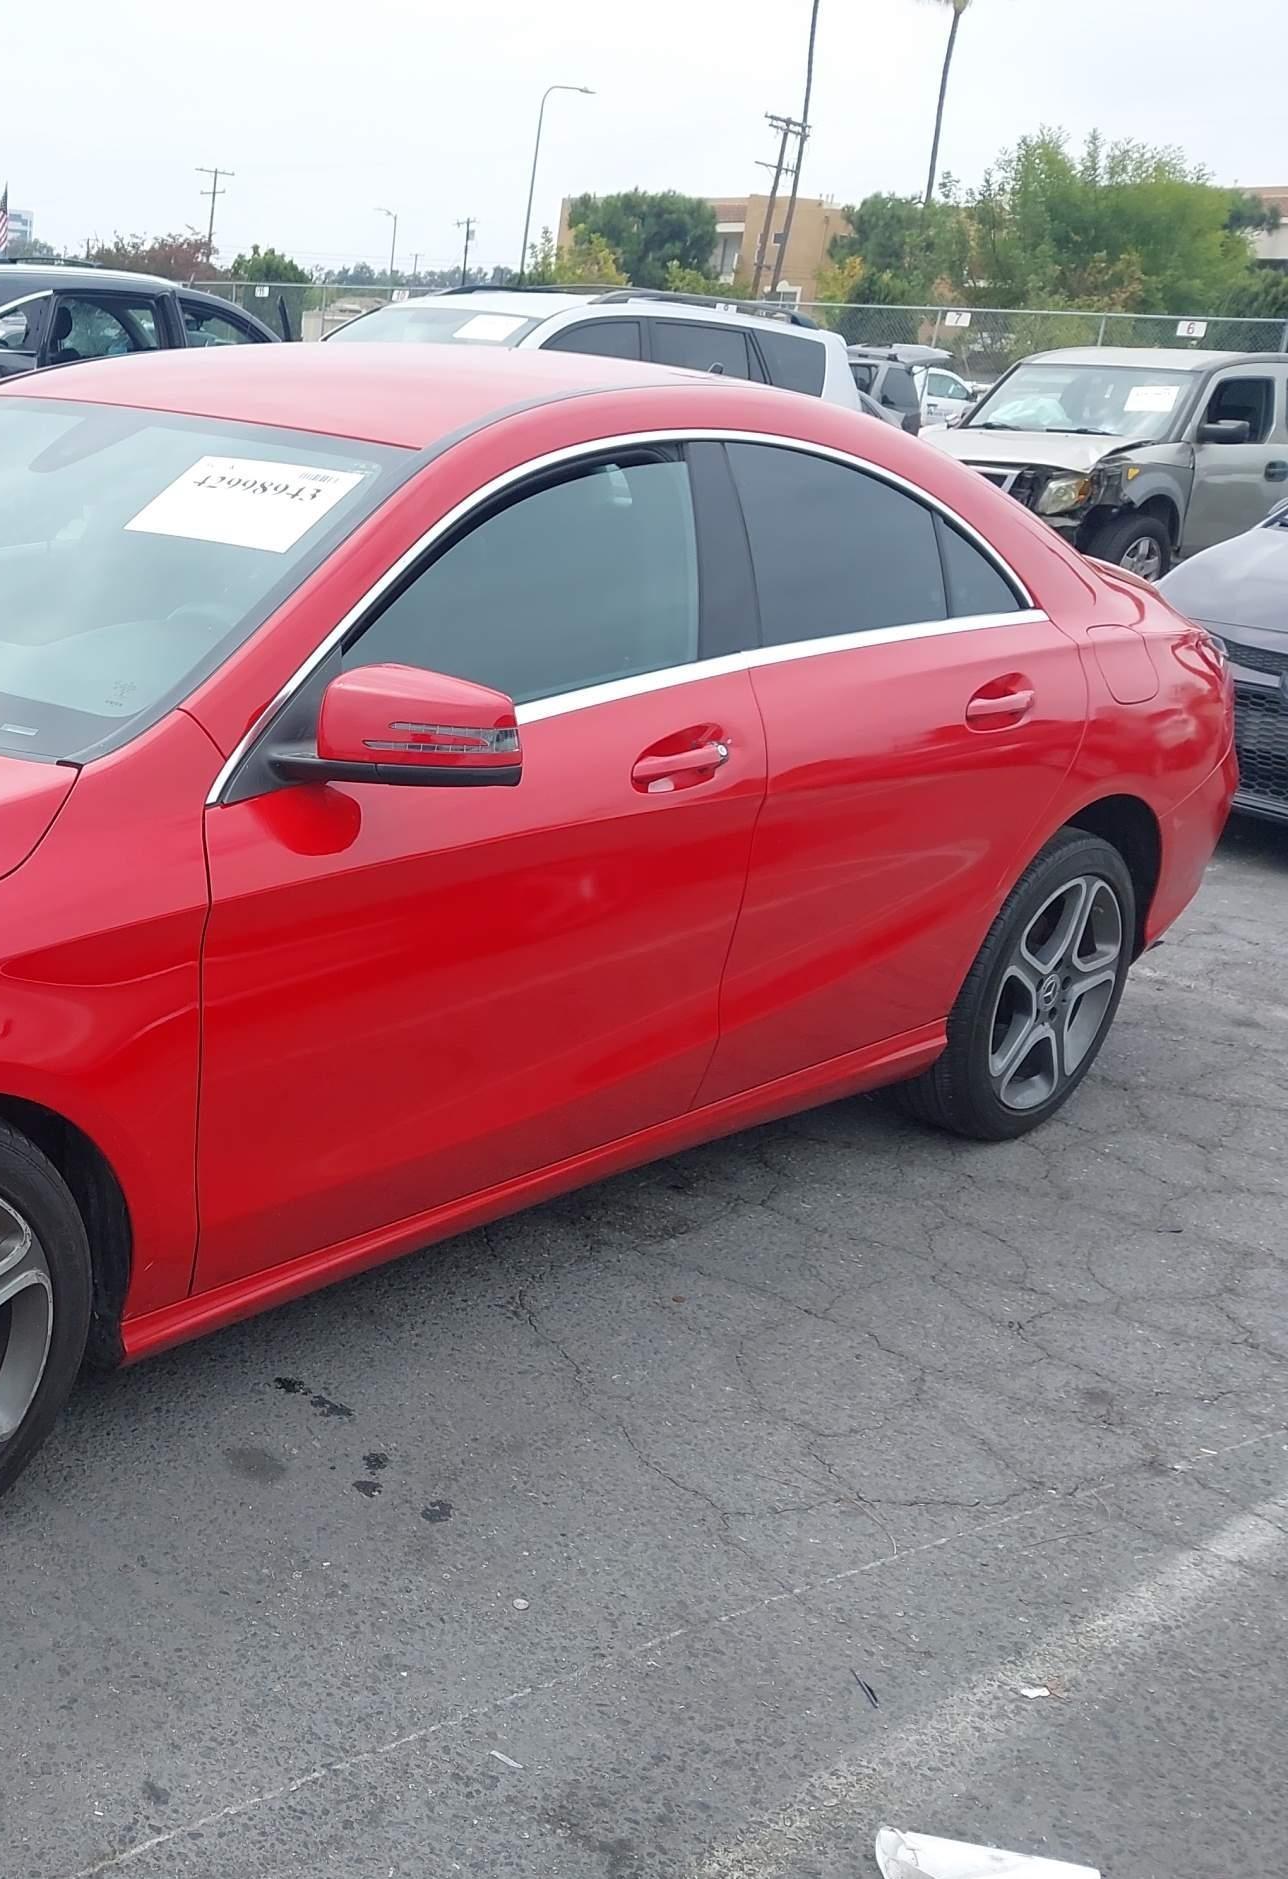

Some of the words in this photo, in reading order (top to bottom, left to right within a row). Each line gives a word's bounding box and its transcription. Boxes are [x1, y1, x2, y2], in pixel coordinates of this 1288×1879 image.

[954, 312, 962, 325] 7
[1186, 322, 1195, 335] 6
[192, 475, 323, 501] 42998943
